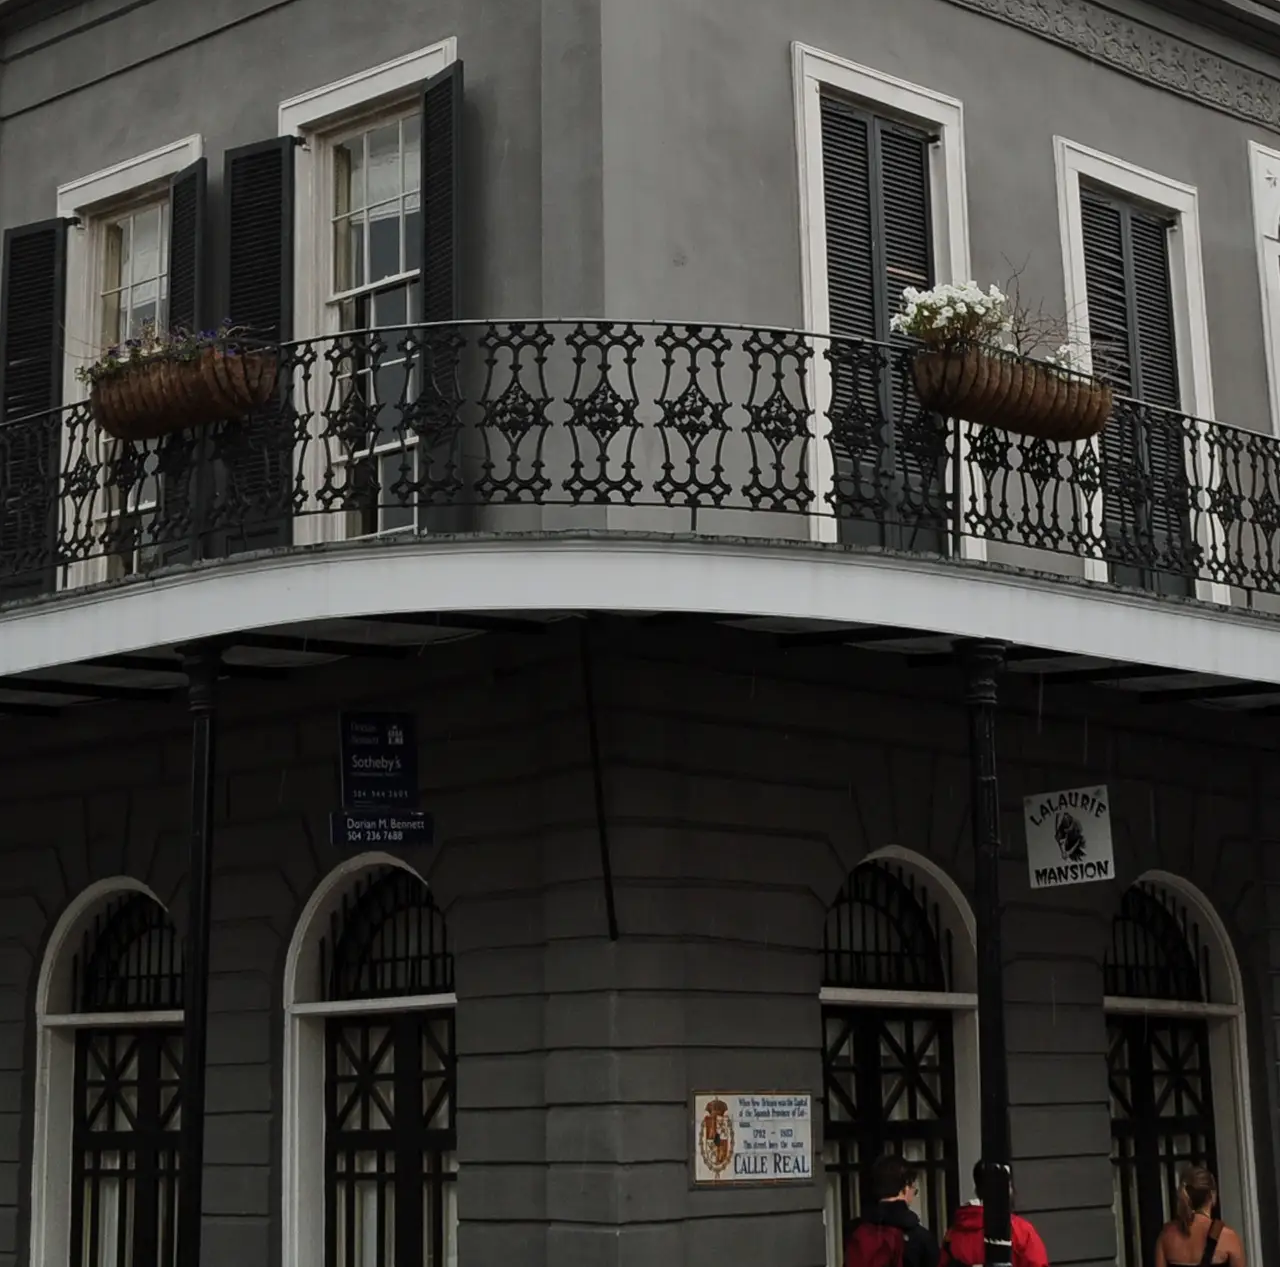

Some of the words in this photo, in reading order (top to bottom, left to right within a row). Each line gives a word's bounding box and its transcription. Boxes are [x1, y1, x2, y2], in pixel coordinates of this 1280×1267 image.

[351, 754, 403, 771] Sotheby's
[1030, 792, 1106, 826] LALAURIE
[346, 817, 377, 829] Dorian
[390, 818, 425, 830] Bennett
[346, 830, 362, 841] 504
[1035, 860, 1109, 885] MANSION
[734, 1153, 768, 1174] CALLE
[773, 1153, 810, 1174] REAL
